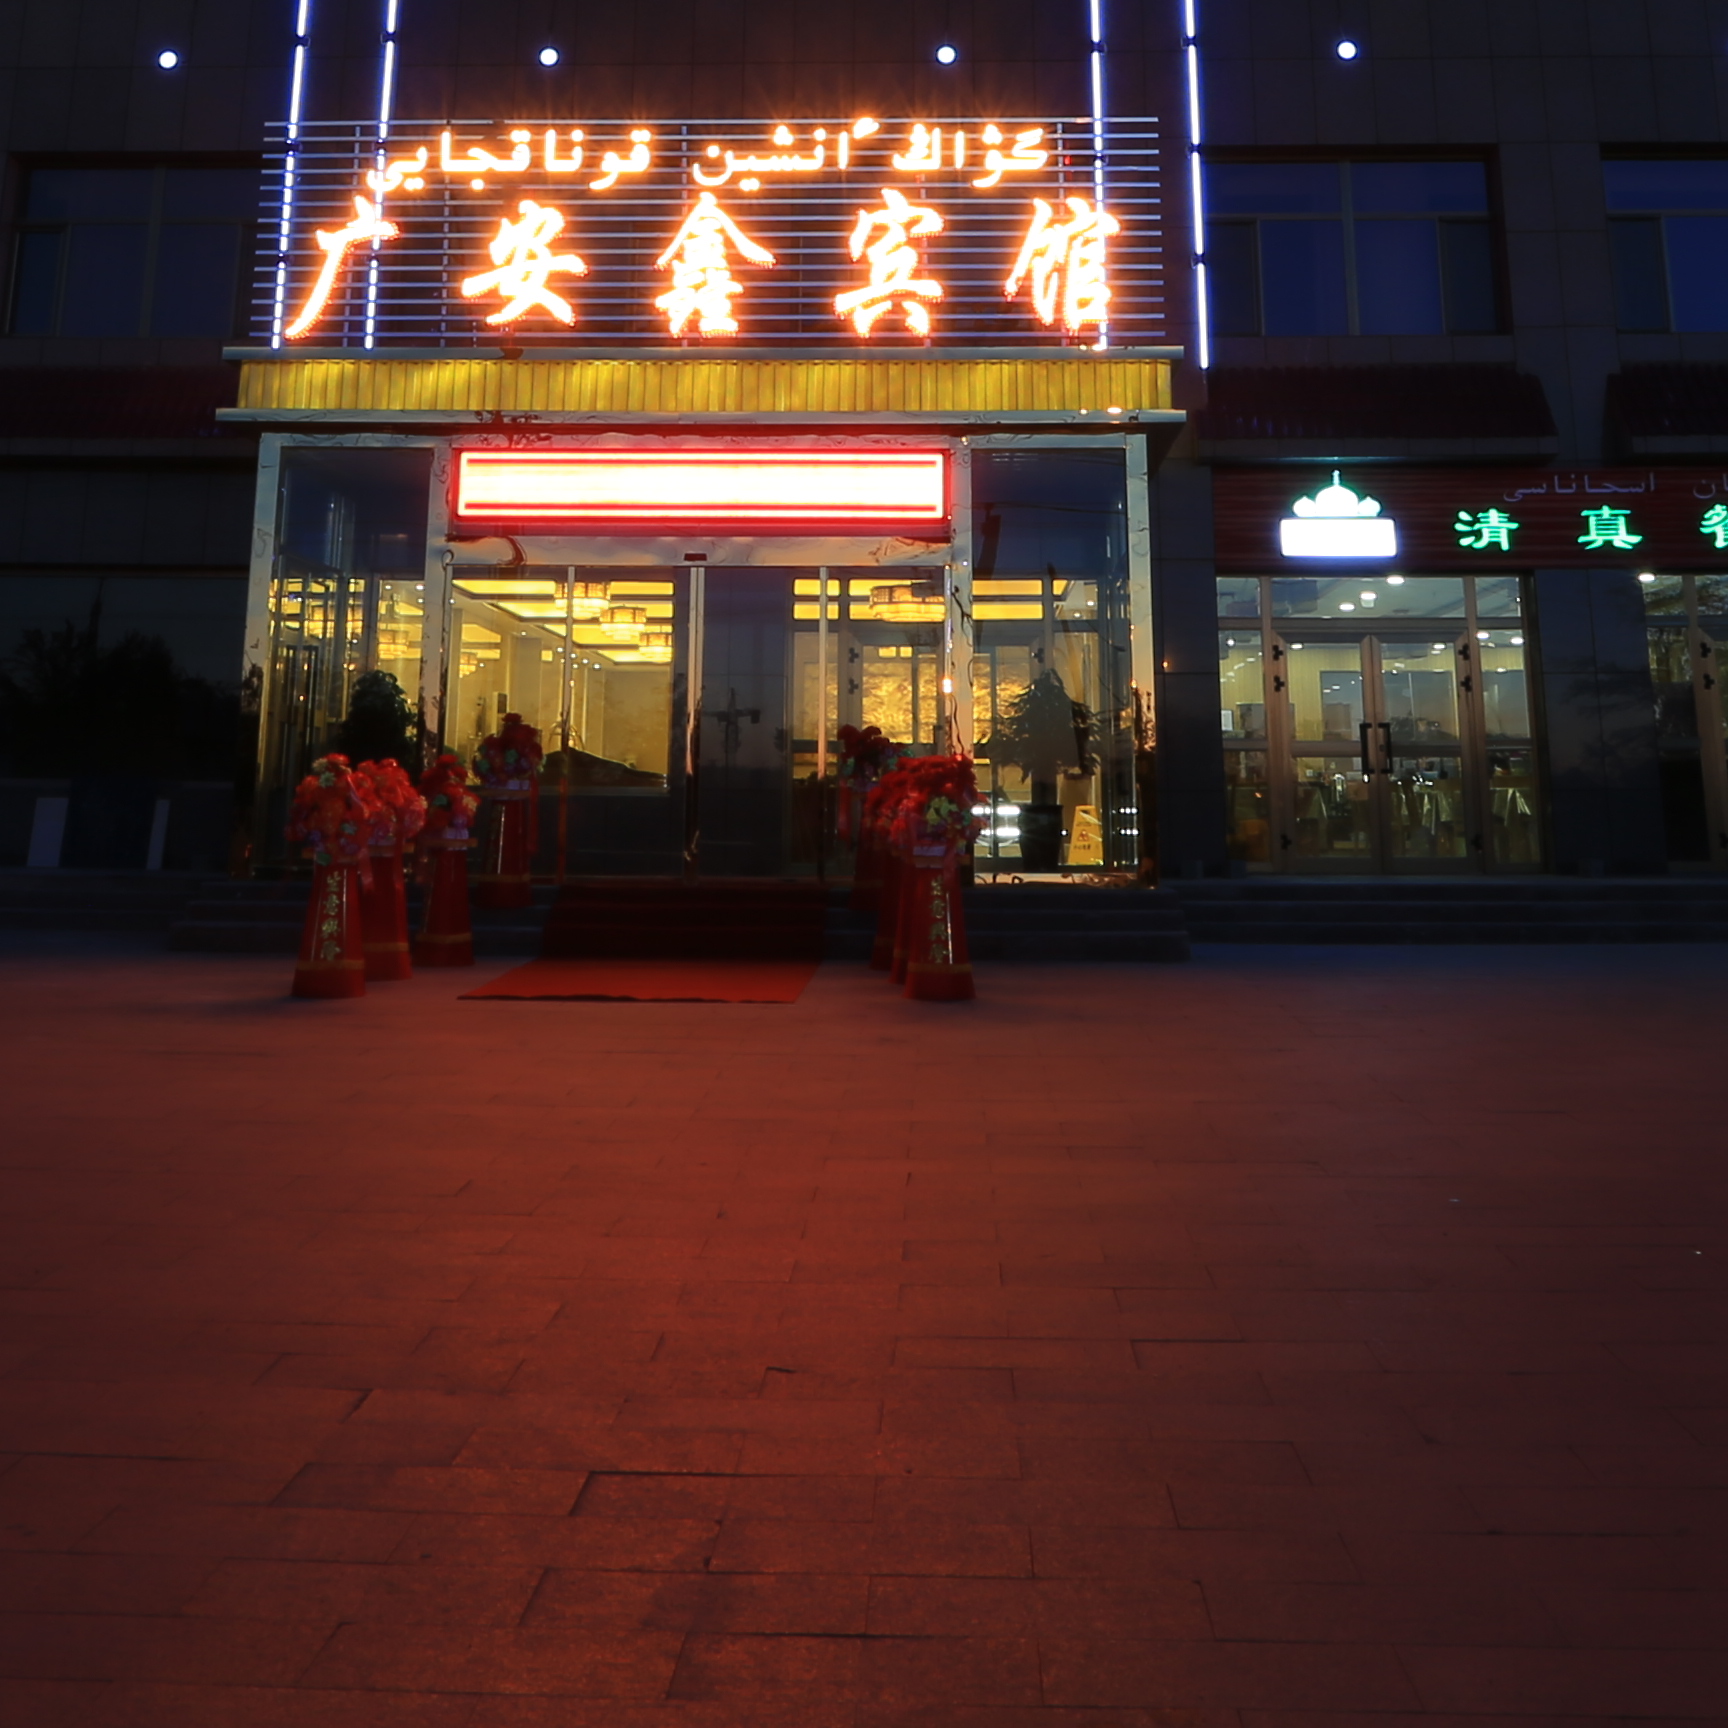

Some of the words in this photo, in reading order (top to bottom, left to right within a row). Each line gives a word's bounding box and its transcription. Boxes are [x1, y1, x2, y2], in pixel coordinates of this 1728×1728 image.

[284, 186, 1123, 341] 广安鑫宾馆
